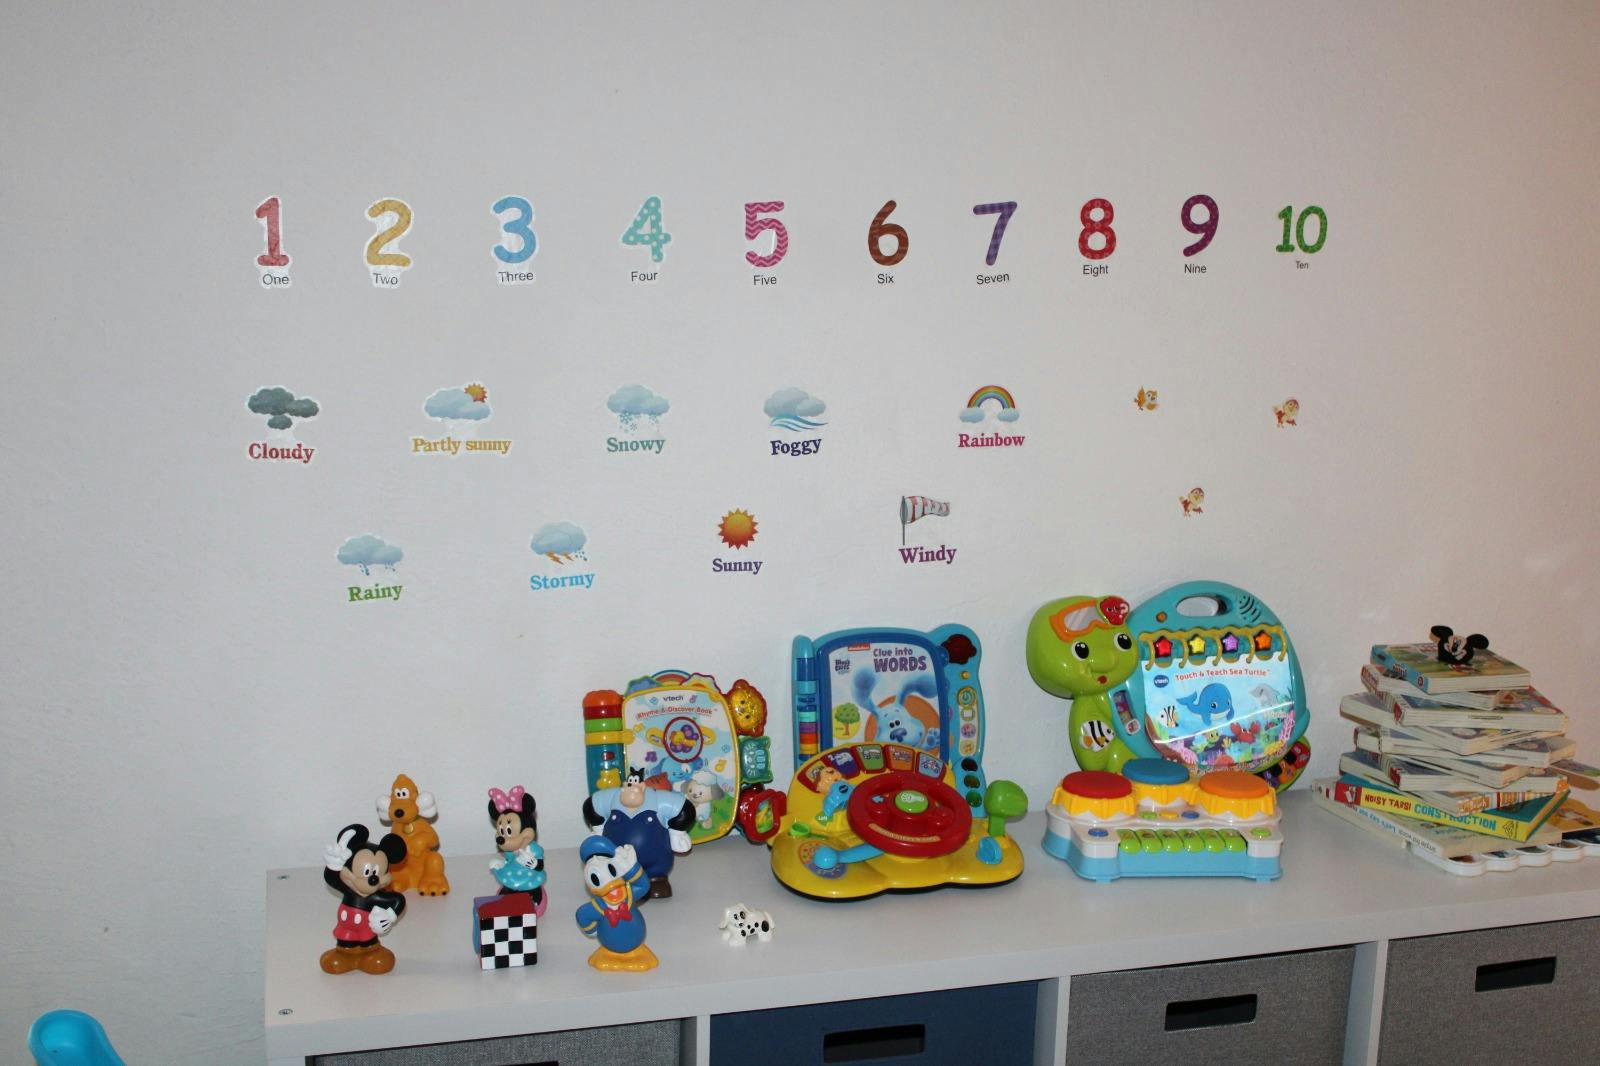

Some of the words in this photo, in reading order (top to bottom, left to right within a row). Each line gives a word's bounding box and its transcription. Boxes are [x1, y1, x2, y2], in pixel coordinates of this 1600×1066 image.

[256, 198, 289, 266] 1
[367, 200, 412, 267] 2
[493, 197, 536, 263] 3
[622, 196, 671, 262] 4
[745, 201, 788, 267] 5
[868, 200, 909, 266] 6
[973, 201, 1017, 266] 7
[1078, 198, 1116, 260] 8
[1181, 195, 1219, 257] 9
[1276, 205, 1328, 254] 10
[1082, 264, 1109, 278] Eight
[1184, 263, 1207, 274] Nine
[1295, 260, 1309, 270] Ten
[262, 273, 290, 286] One
[372, 272, 399, 286] Two
[497, 271, 534, 283] Three
[630, 270, 659, 282] Four
[753, 274, 777, 286] Five
[877, 273, 895, 285] Six
[976, 273, 1010, 286] Seven
[413, 437, 461, 455] Partly
[465, 440, 511, 455] sunny
[607, 437, 665, 454] Snowy
[770, 439, 822, 456] Foggy
[958, 432, 1025, 448] Rainbow
[249, 443, 314, 464] Cloudy
[898, 543, 957, 564] Windy
[712, 558, 763, 575] Sunny
[530, 574, 595, 590] Stormy
[348, 584, 403, 602] Rainy
[873, 648, 893, 657] Clue
[895, 647, 913, 656] into
[873, 655, 927, 672] WORDS
[1175, 672, 1198, 680] Touch
[1364, 793, 1387, 806] NOISY
